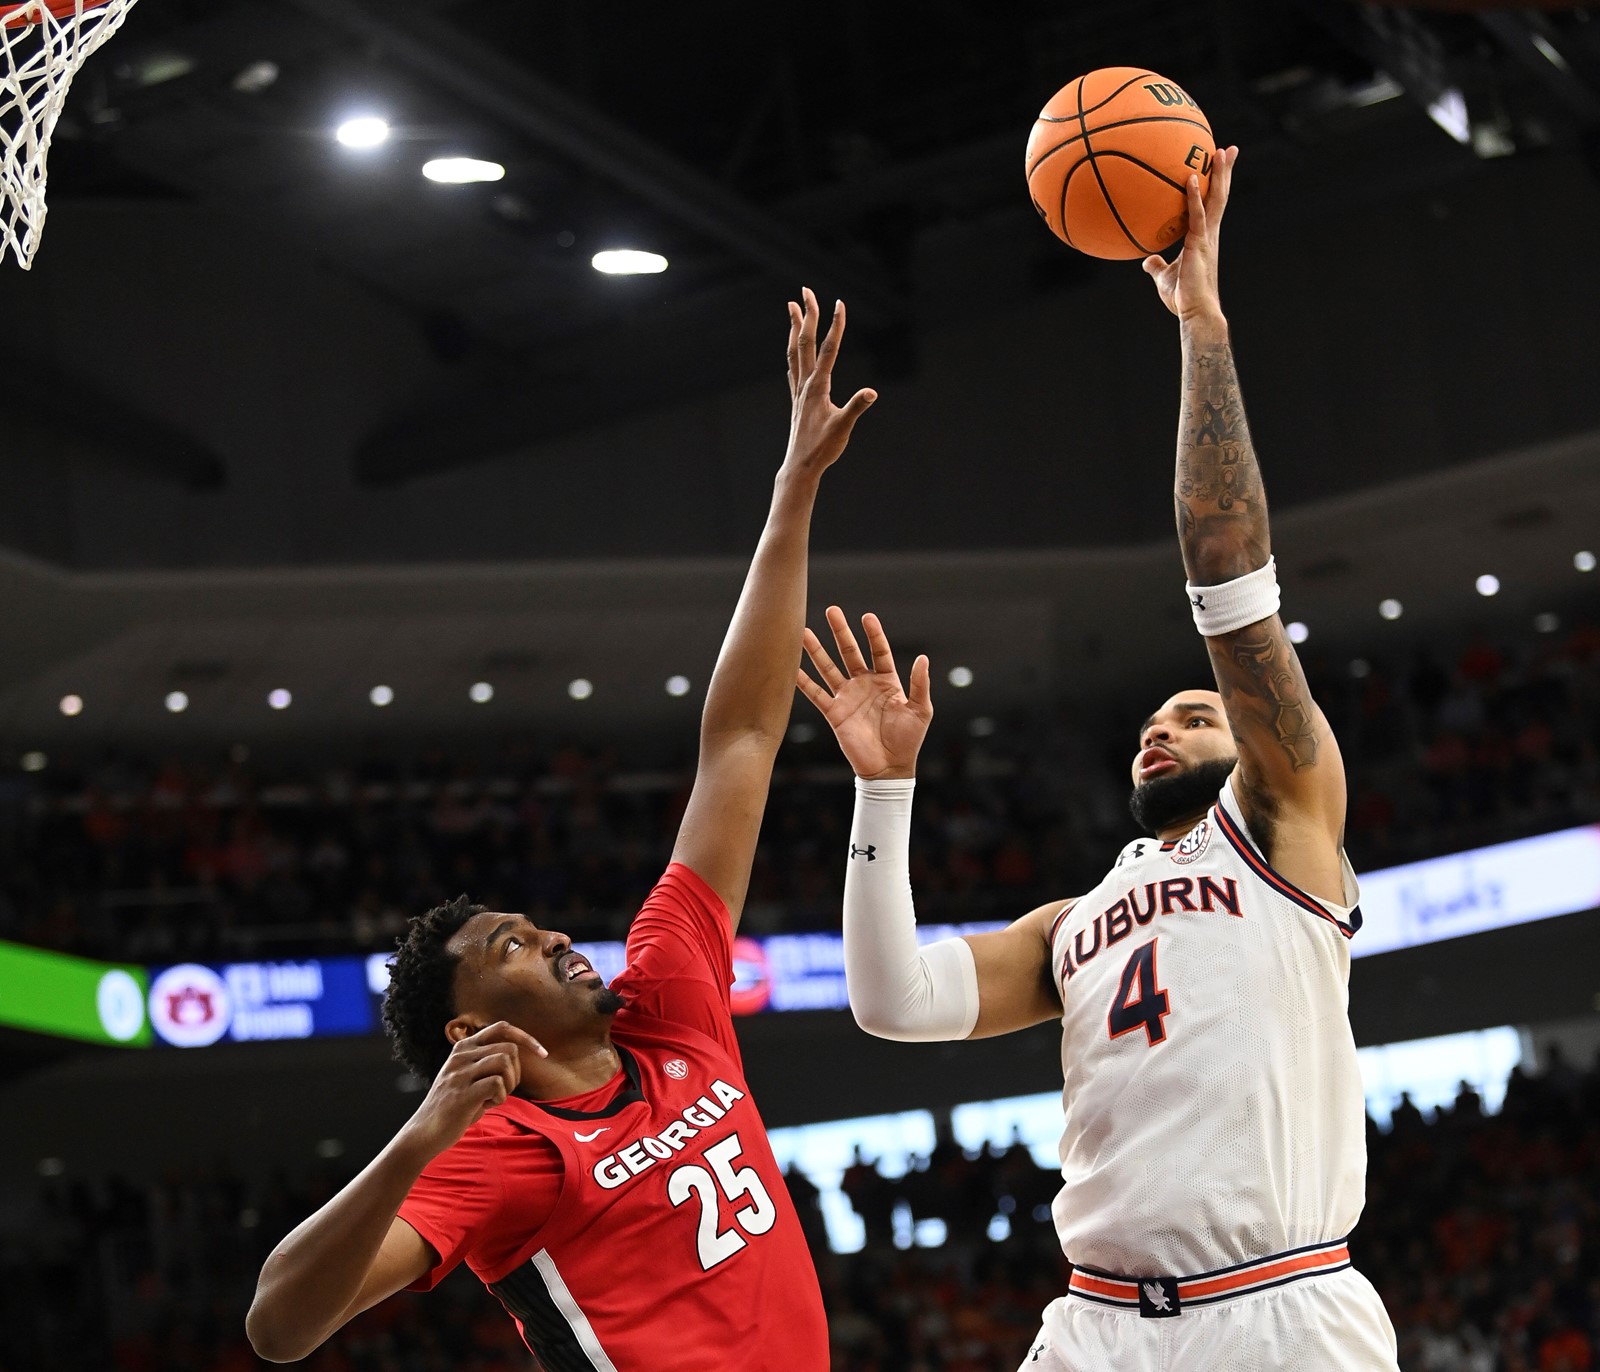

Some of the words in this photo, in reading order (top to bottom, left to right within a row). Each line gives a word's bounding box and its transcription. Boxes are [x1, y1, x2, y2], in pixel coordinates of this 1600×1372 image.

[1181, 823, 1206, 852] SEC
[1061, 876, 1244, 998] AUBURN
[1107, 937, 1171, 1048] 4
[592, 1078, 746, 1190] GEORGIA
[666, 1131, 776, 1272] 25
